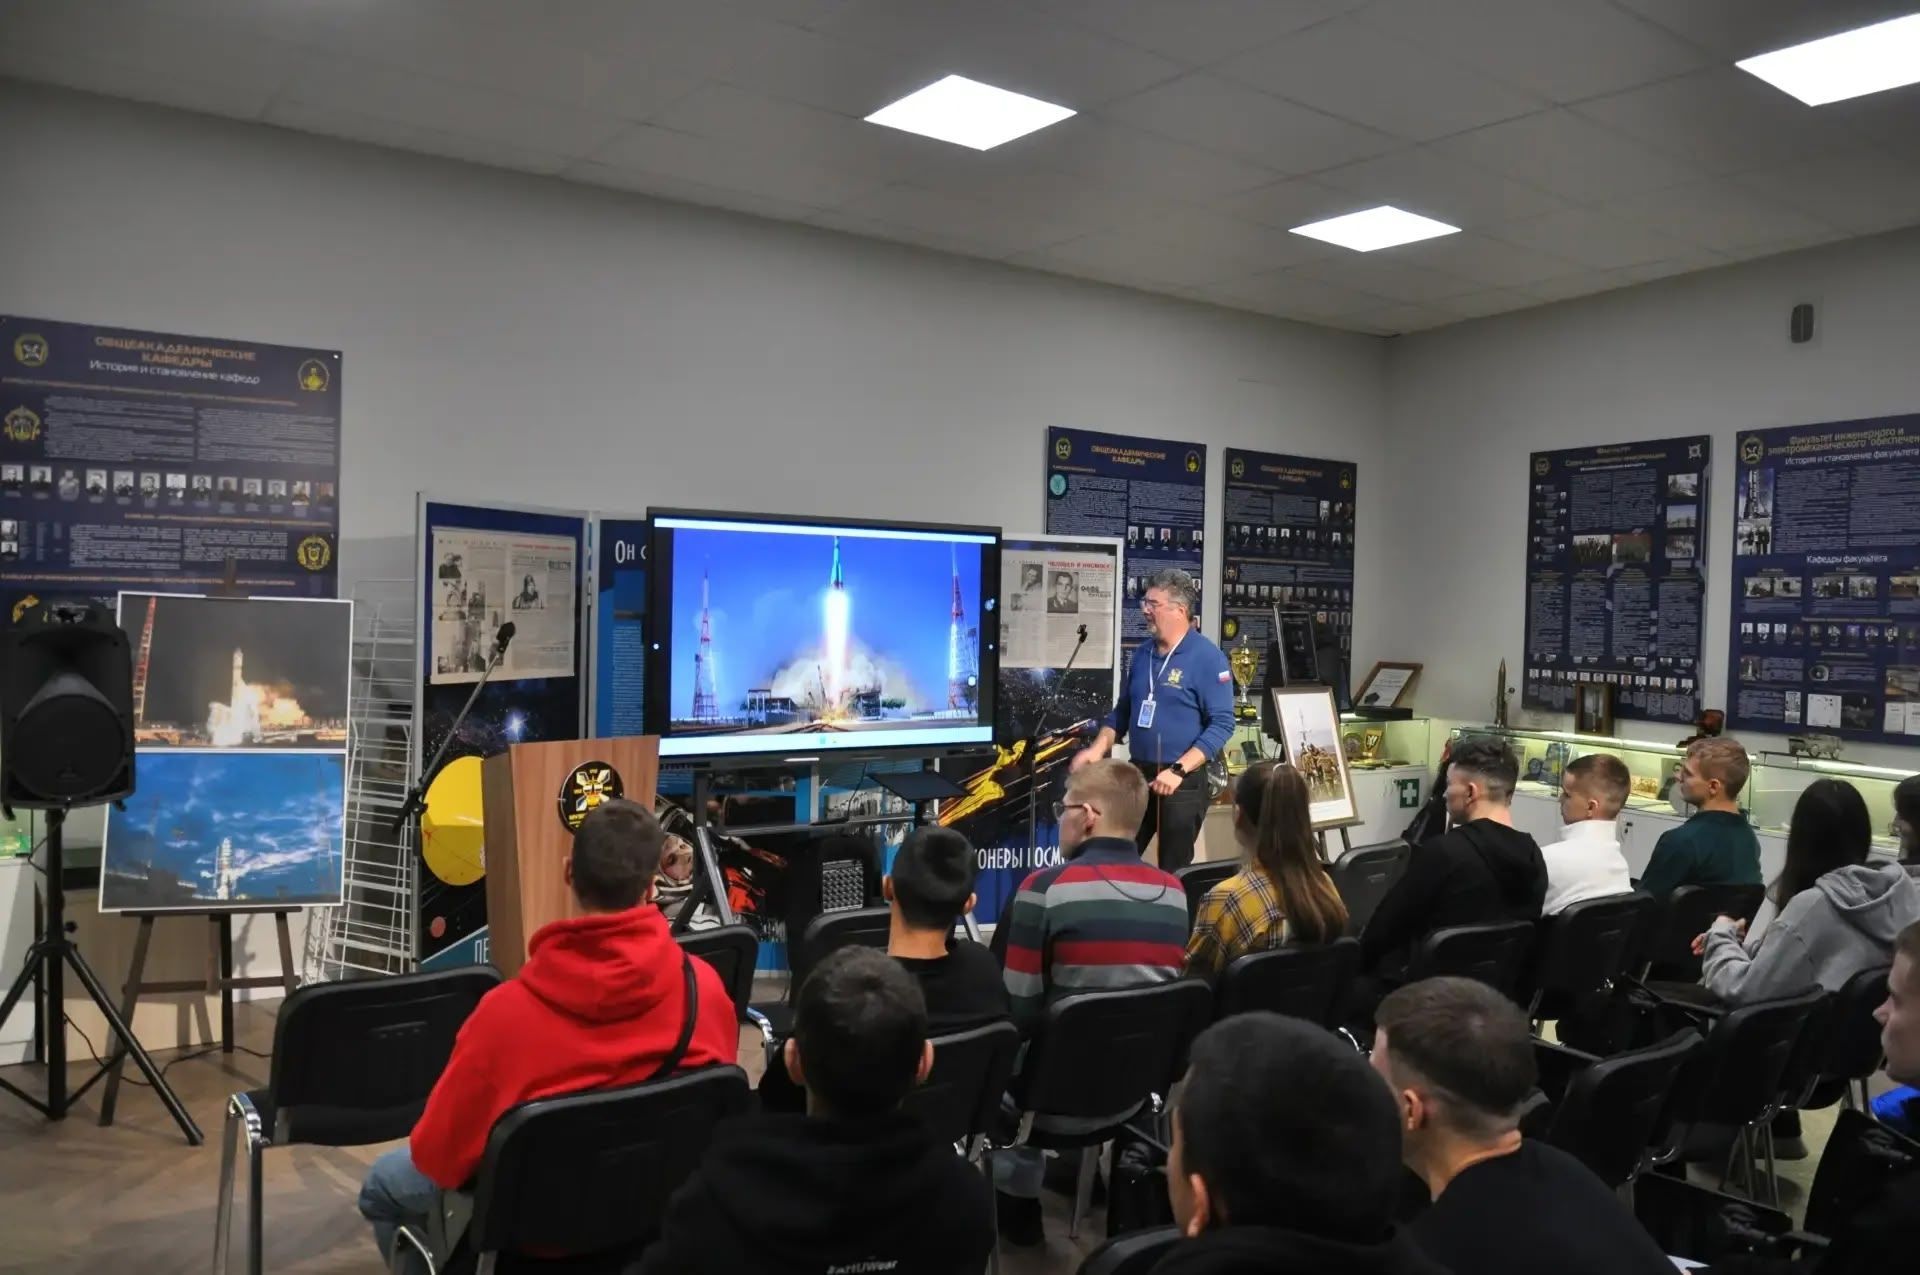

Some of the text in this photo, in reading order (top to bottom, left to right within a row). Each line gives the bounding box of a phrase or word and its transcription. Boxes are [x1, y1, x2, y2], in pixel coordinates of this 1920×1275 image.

[141, 352, 213, 368] КАФЕДРЫ
[89, 360, 138, 374] История
[140, 365, 148, 374] и
[150, 367, 218, 381] становление
[1785, 456, 1816, 465] История
[1823, 452, 1872, 462] становление
[1806, 555, 1888, 564] Кафедры факультета
[975, 848, 1023, 870] ОНЕРЫ
